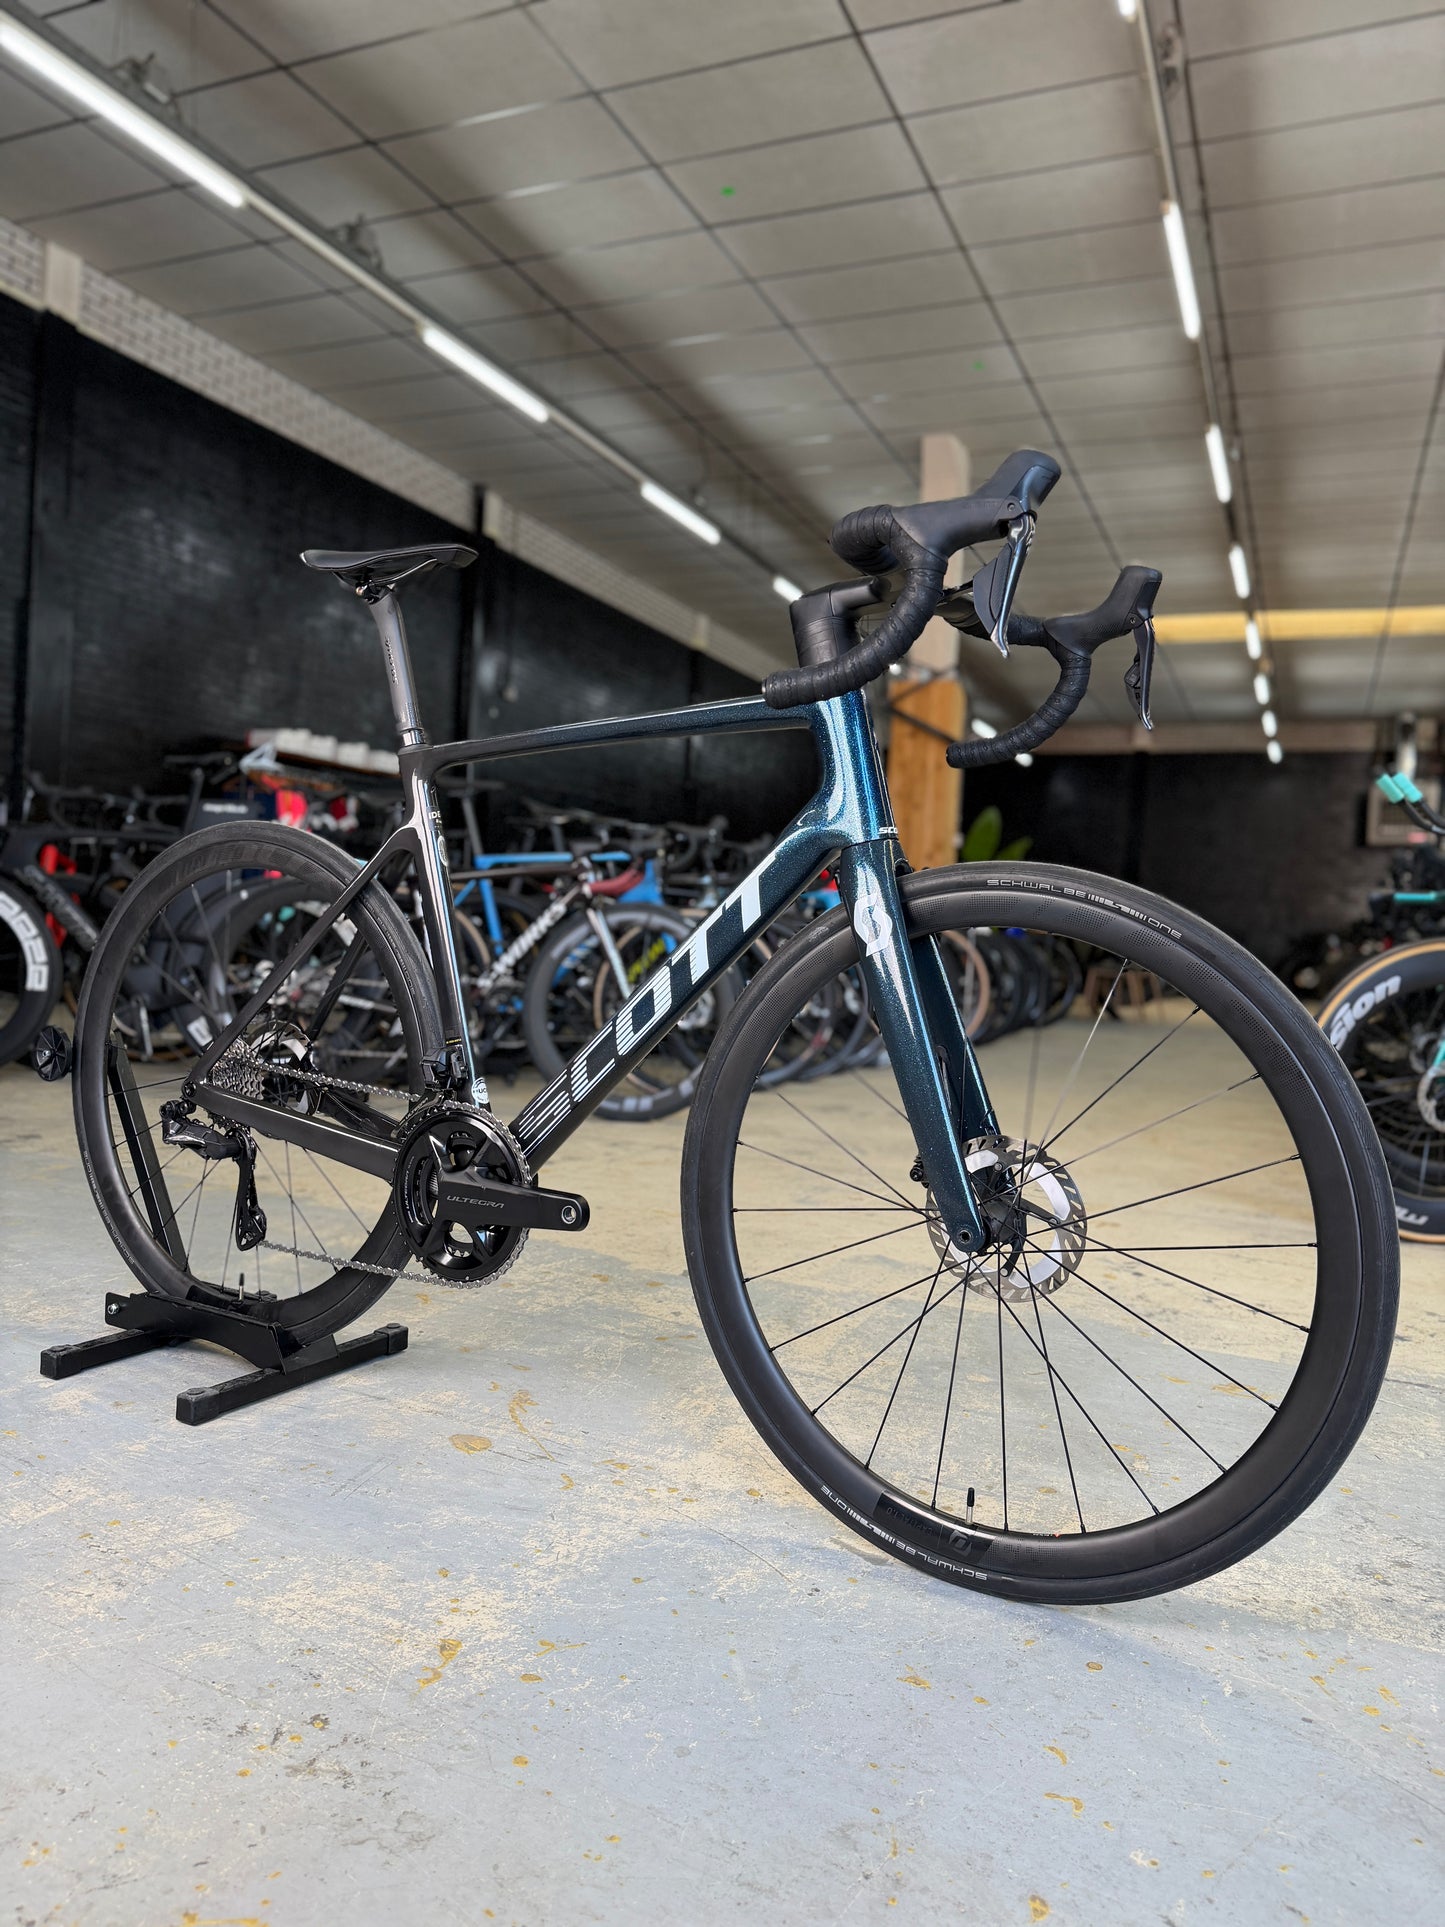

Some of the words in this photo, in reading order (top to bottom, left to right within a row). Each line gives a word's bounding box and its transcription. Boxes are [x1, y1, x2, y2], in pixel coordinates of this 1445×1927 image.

[878, 826, 898, 835] SCO
[986, 879, 1086, 899] SCHWALBE
[1147, 918, 1183, 940] ONE
[518, 849, 777, 1157] SCOTT
[1330, 975, 1401, 1051] sion
[446, 1195, 505, 1209] ULTEGRA
[820, 1485, 848, 1510] ONE
[895, 1540, 988, 1581] SCHWALBE
